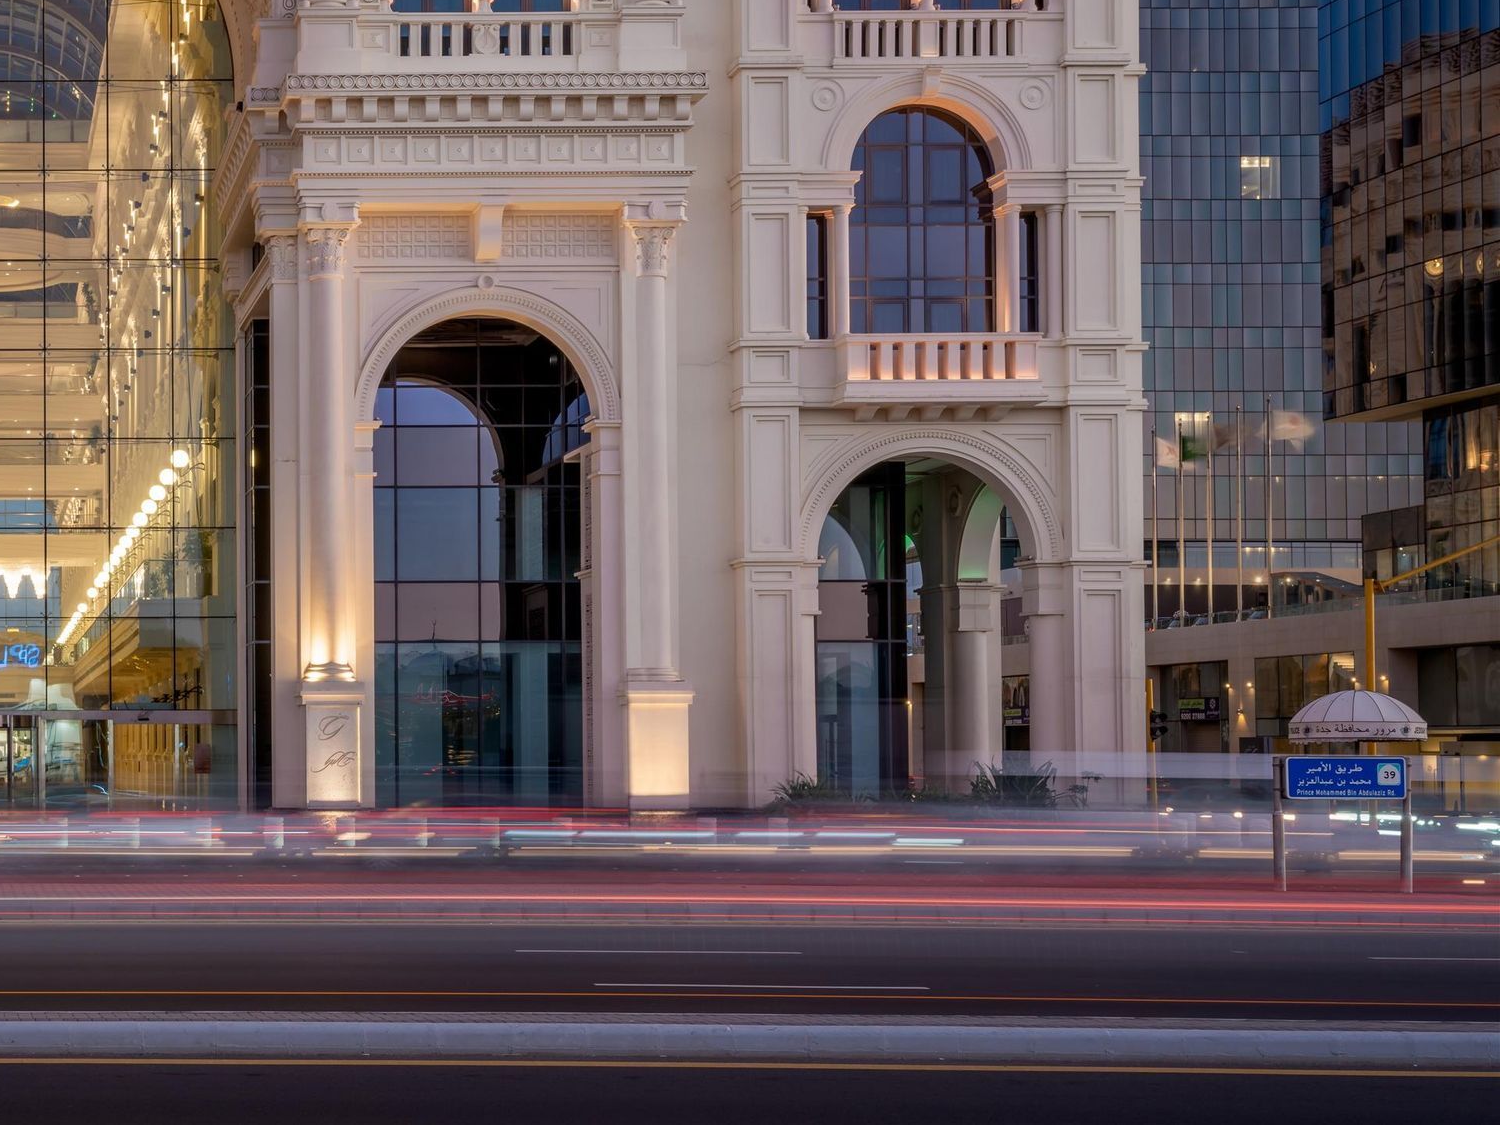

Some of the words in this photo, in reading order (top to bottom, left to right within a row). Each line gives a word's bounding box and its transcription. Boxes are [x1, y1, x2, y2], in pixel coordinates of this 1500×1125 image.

[1315, 724, 1332, 735] جدة
[1334, 723, 1370, 733] محافظة
[1373, 725, 1396, 736] مرور
[1306, 761, 1332, 774] الأمير
[1335, 764, 1363, 774] طريق
[1383, 770, 1396, 780] 39
[1297, 775, 1334, 787] عبدالعزيز
[1336, 777, 1346, 787] بن
[1296, 788, 1314, 796] Prince
[1315, 788, 1346, 796] Mohammed
[1347, 788, 1357, 796] Bin
[1358, 788, 1386, 796] Abdulaziz
[1387, 788, 1397, 796] Rd.
